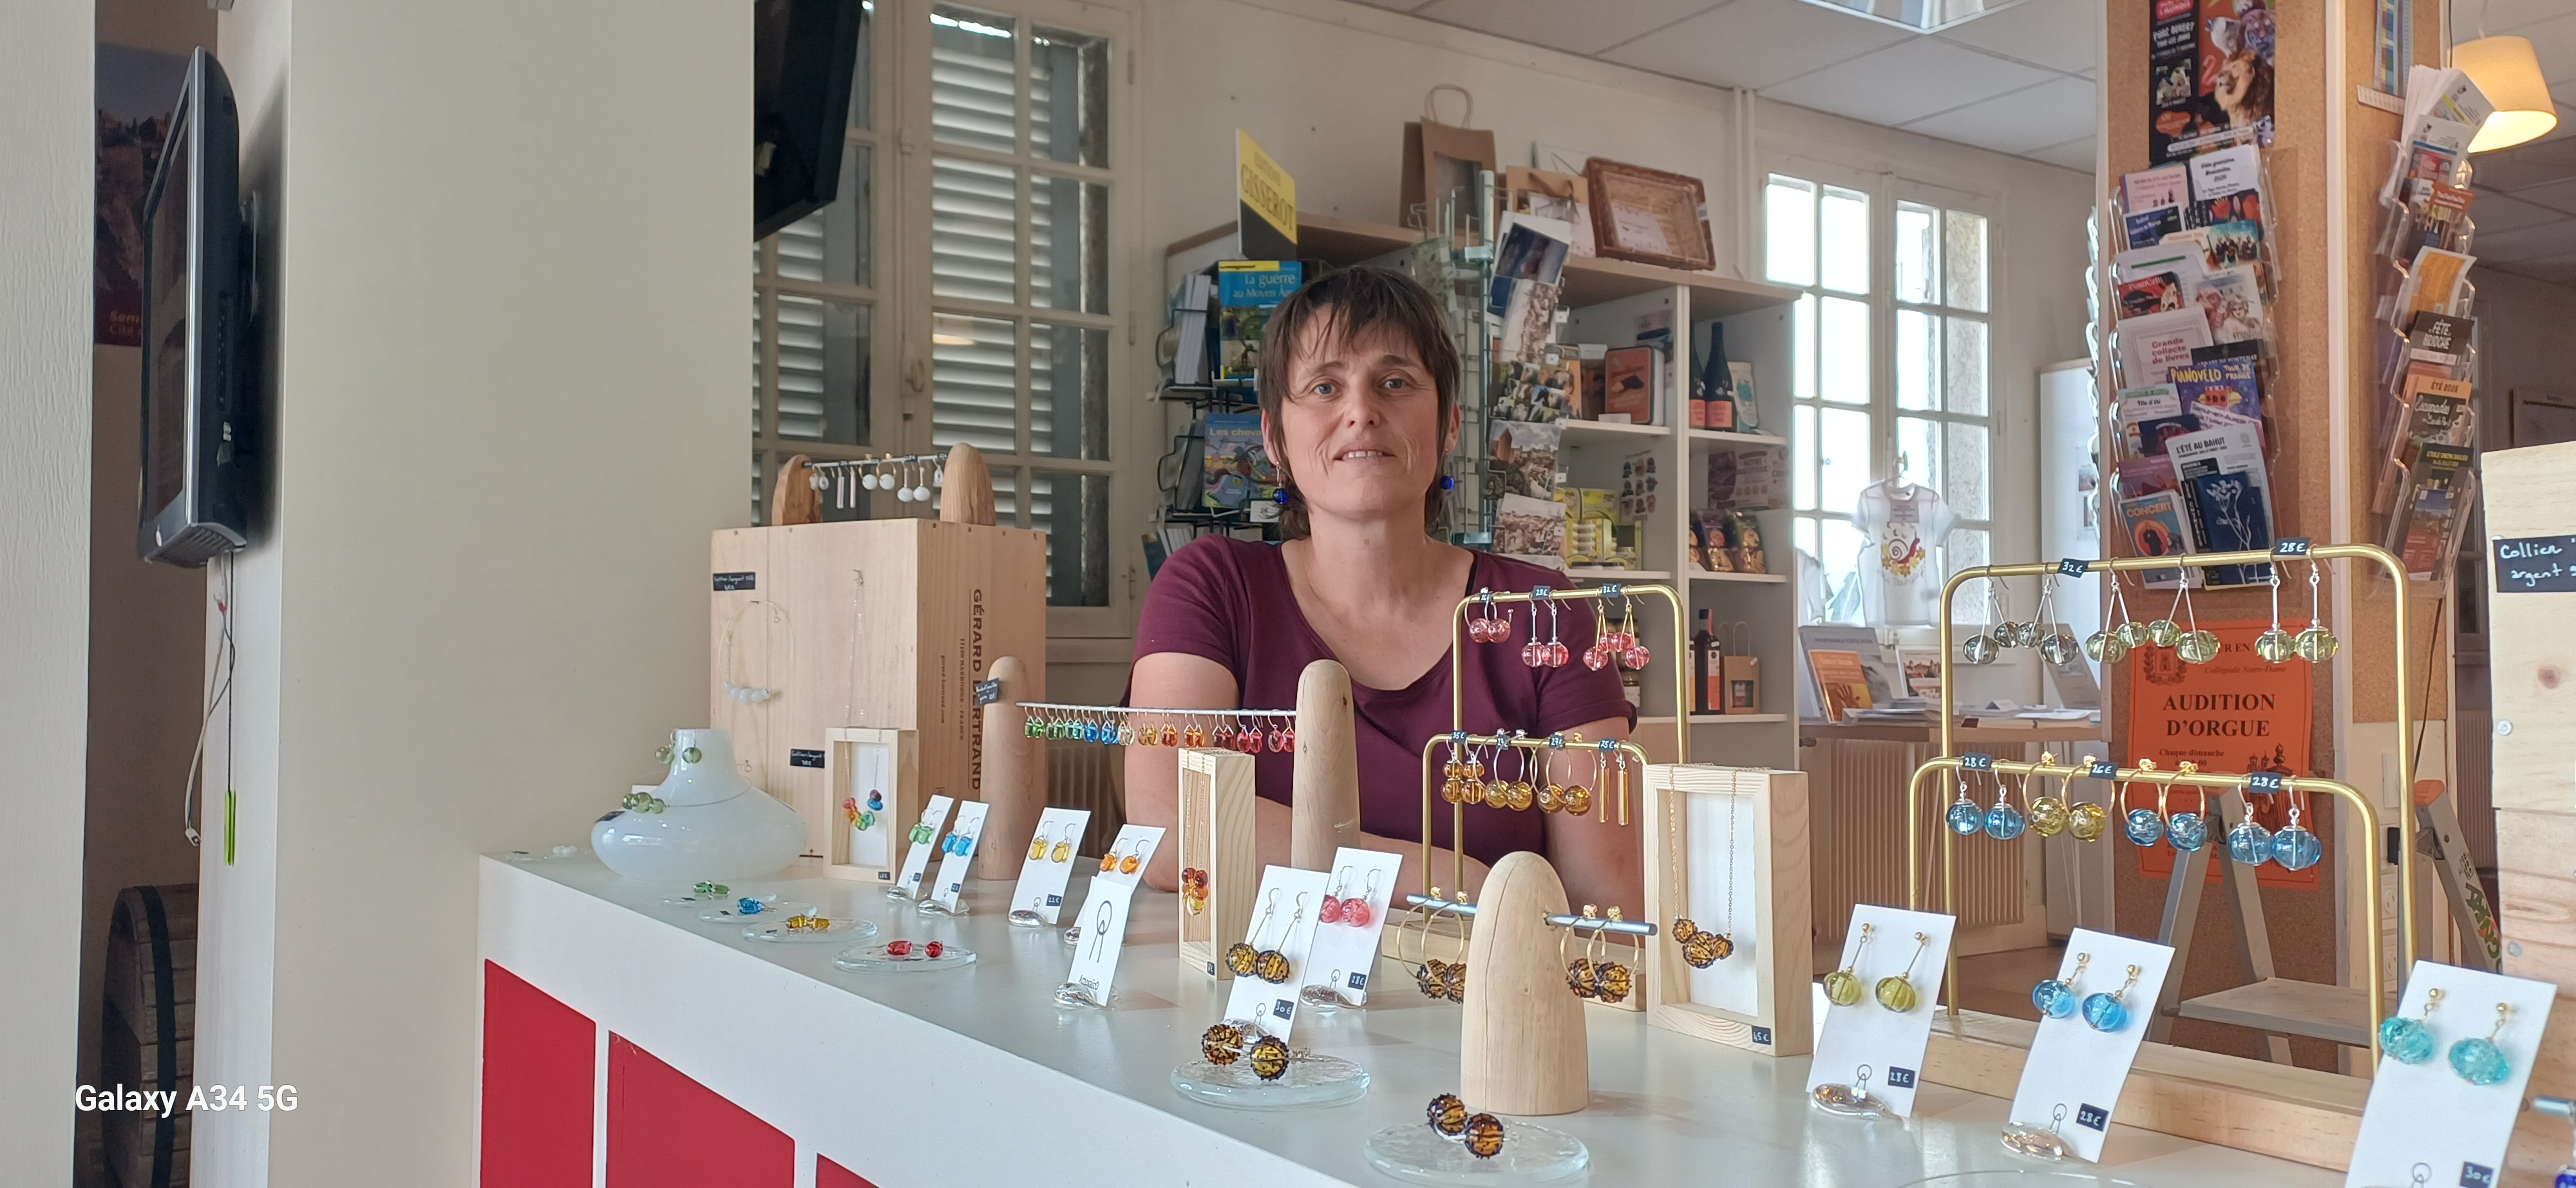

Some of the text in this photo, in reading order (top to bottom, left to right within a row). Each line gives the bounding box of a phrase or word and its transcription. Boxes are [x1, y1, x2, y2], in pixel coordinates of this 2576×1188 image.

[1245, 274, 1296, 289] La guerre
[1246, 288, 1276, 299] Moyen
[2152, 338, 2184, 349] Grande
[2152, 347, 2186, 357] collecte
[2165, 353, 2190, 363] livres
[1209, 427, 1229, 436] Les
[2194, 439, 2203, 448] AU
[2204, 436, 2226, 448] BAHUT
[2126, 501, 2173, 518] CONCERT
[2279, 542, 2306, 553] 28€
[2500, 542, 2562, 559] Collier
[2062, 561, 2083, 573] 32€
[2511, 562, 2563, 587] argent
[972, 588, 985, 673] GÉRARD
[2204, 665, 2287, 674] Collégiale Notre-Dame
[2163, 693, 2276, 711] AUDITION
[2166, 720, 2270, 737] D'ORGUE
[2159, 748, 2225, 758] Chaque dimanche
[1965, 757, 1987, 767] 28€
[2251, 776, 2280, 789] 28€
[1276, 1001, 1292, 1015] 30€
[1753, 1030, 1770, 1042] 45€
[1890, 1071, 1910, 1083] 28€
[2080, 1110, 2101, 1126] 28€
